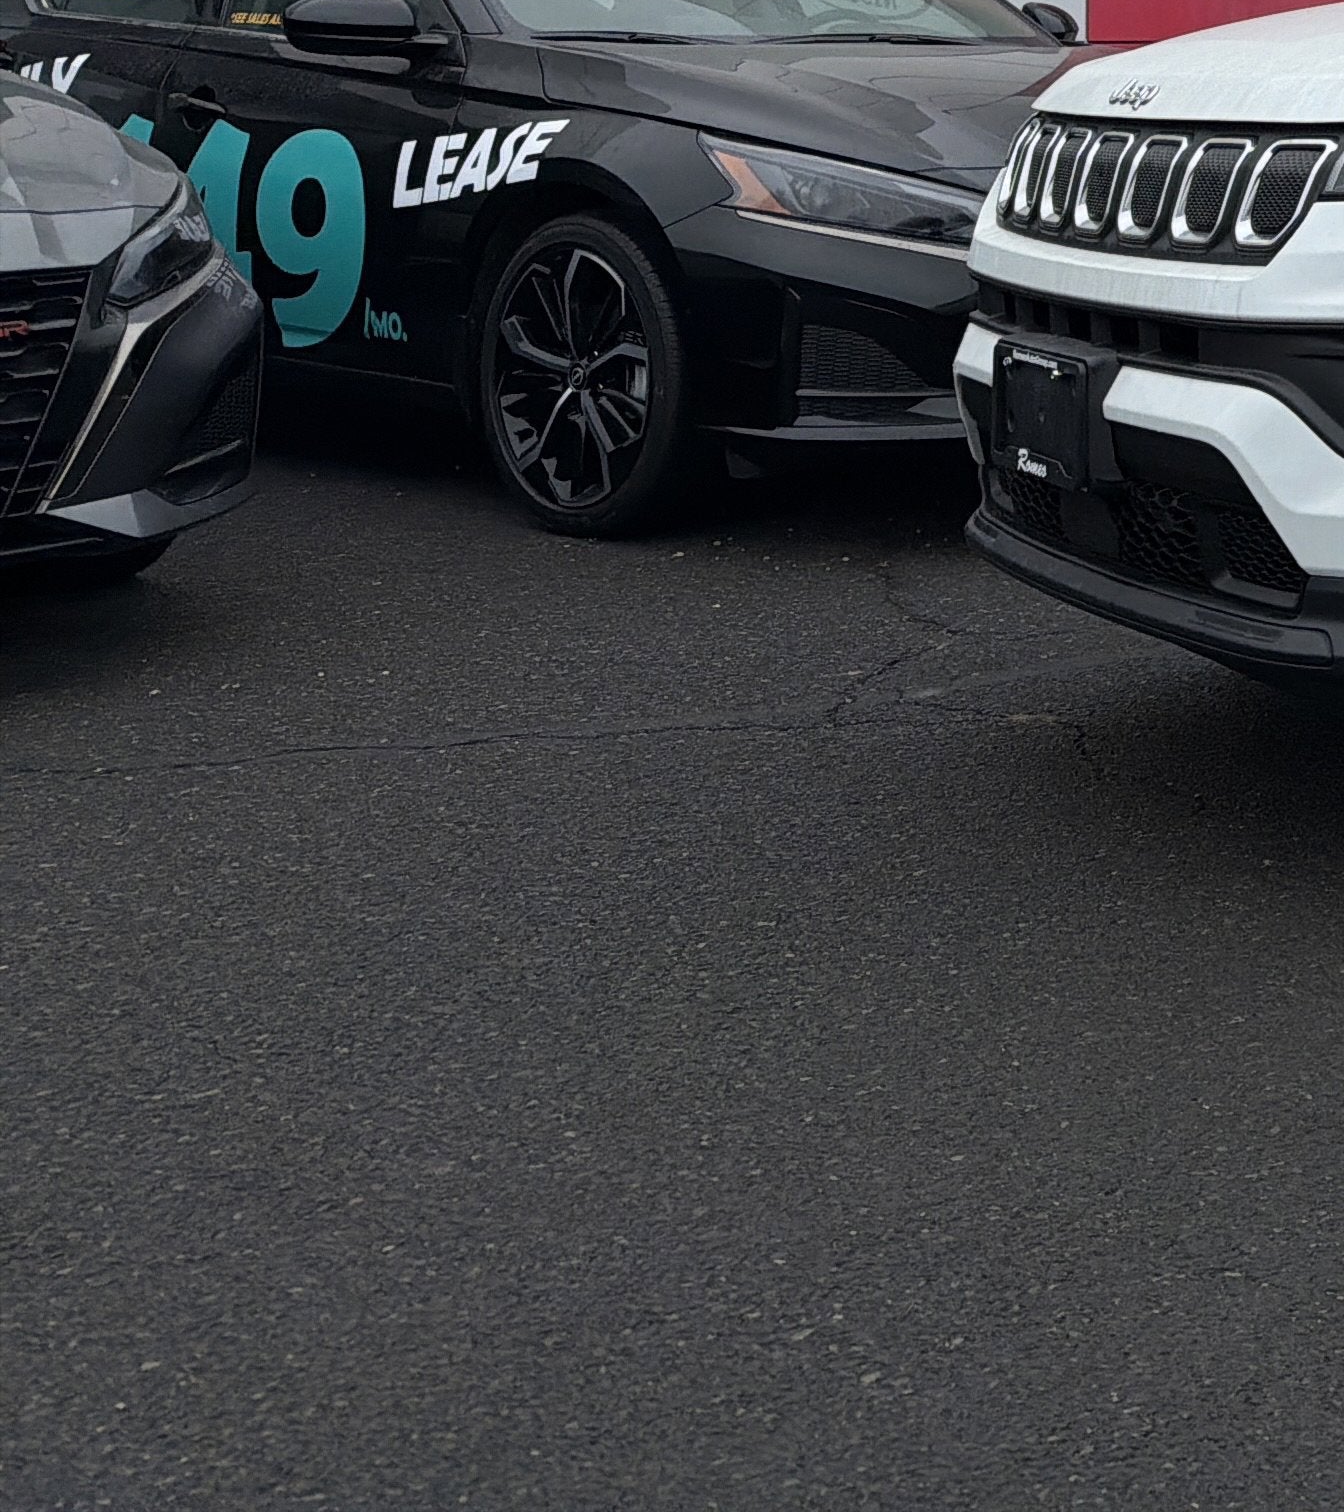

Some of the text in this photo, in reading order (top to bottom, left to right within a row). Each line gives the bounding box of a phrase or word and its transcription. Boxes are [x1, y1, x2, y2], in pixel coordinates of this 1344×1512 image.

[1108, 77, 1160, 111] Jeep
[392, 118, 571, 209] LEASE
[118, 113, 366, 348] 49
